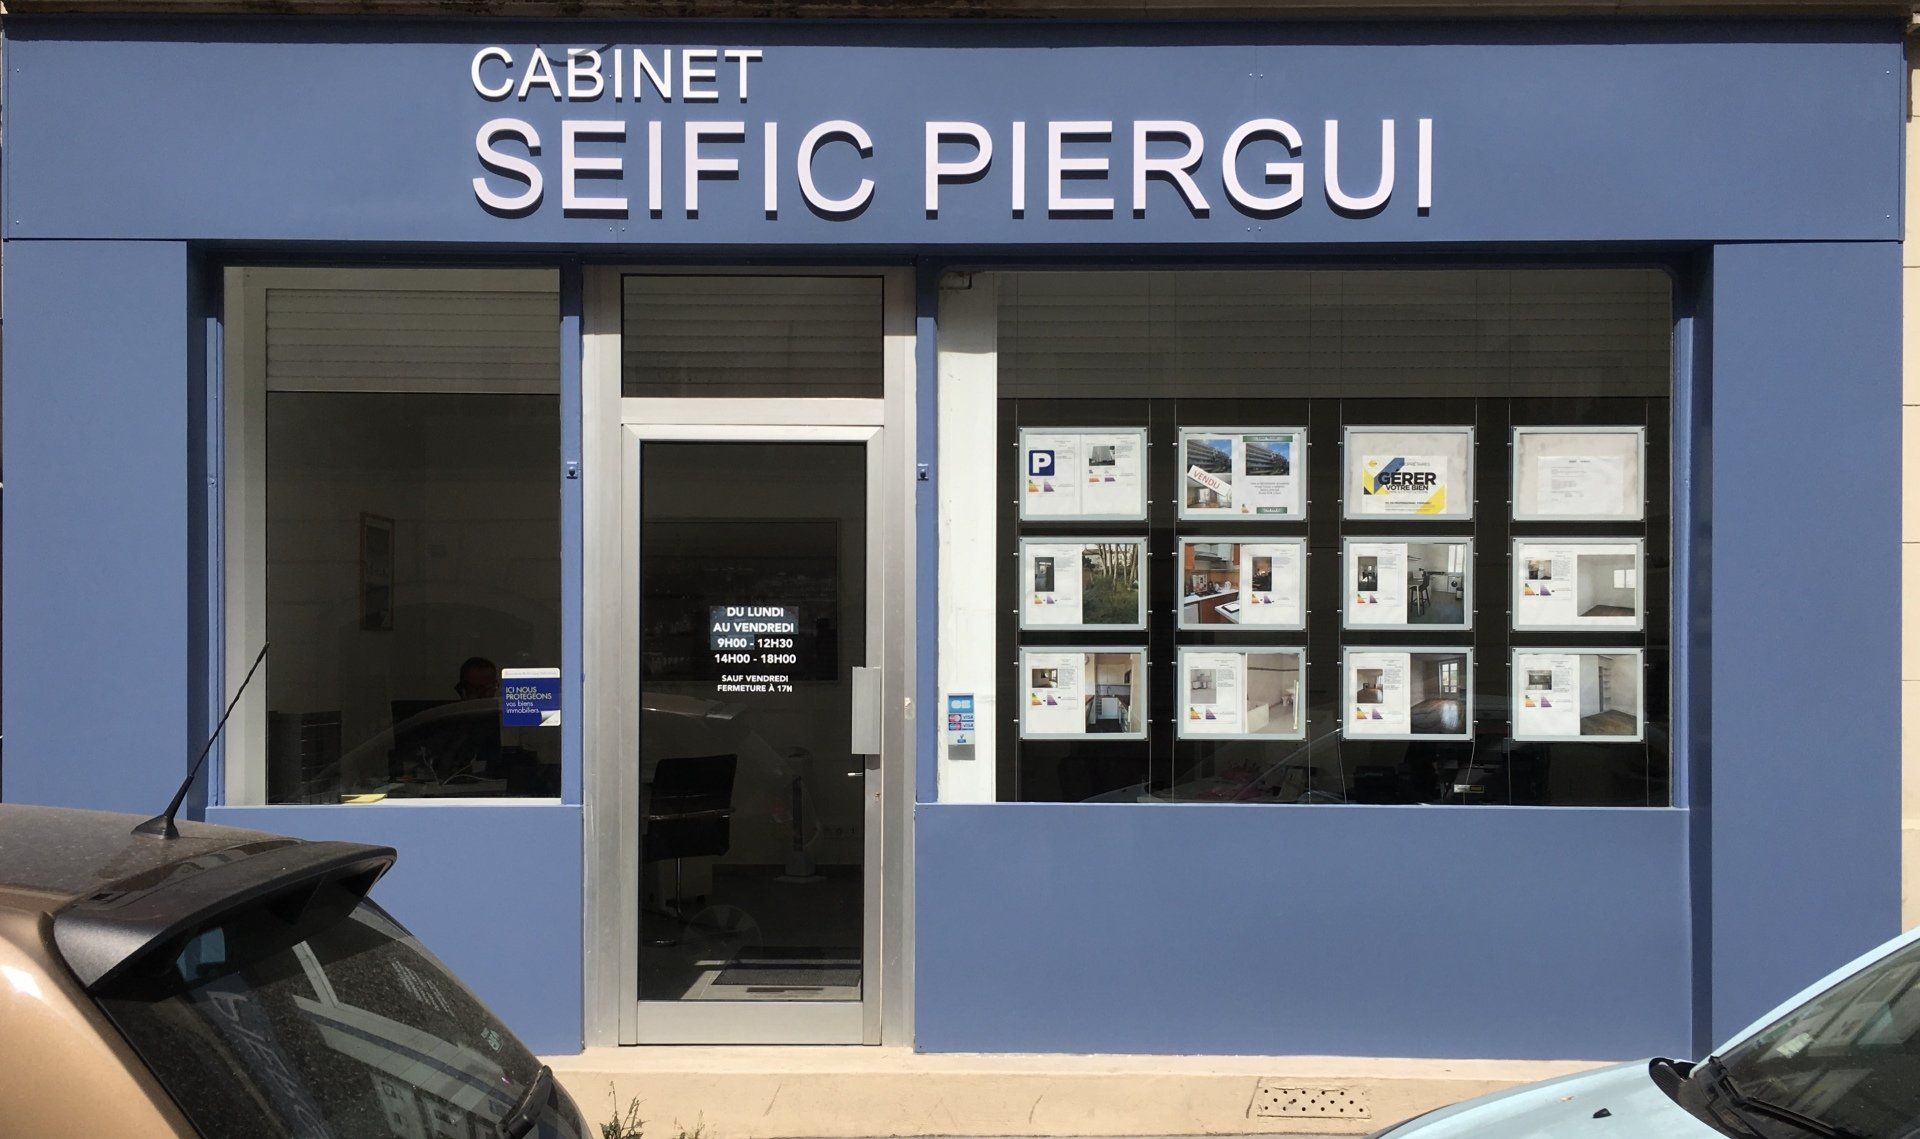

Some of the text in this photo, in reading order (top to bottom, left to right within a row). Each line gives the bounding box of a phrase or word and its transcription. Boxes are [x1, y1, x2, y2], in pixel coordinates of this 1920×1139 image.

[471, 46, 763, 100] CABINET
[472, 117, 1433, 214] SEIFIC PIERGUI
[1193, 469, 1221, 489] VENDU
[1378, 468, 1437, 486] GÉRER
[726, 606, 784, 617] DU LUNDI
[713, 622, 794, 633] AU VENDREDI
[717, 637, 748, 648] 9H00
[757, 638, 794, 648] 12H30
[714, 653, 751, 664] 14H00
[760, 654, 797, 664] 18H00
[721, 674, 789, 683] SAUF VENDREDI
[717, 683, 793, 693] FERMETURE À 17H
